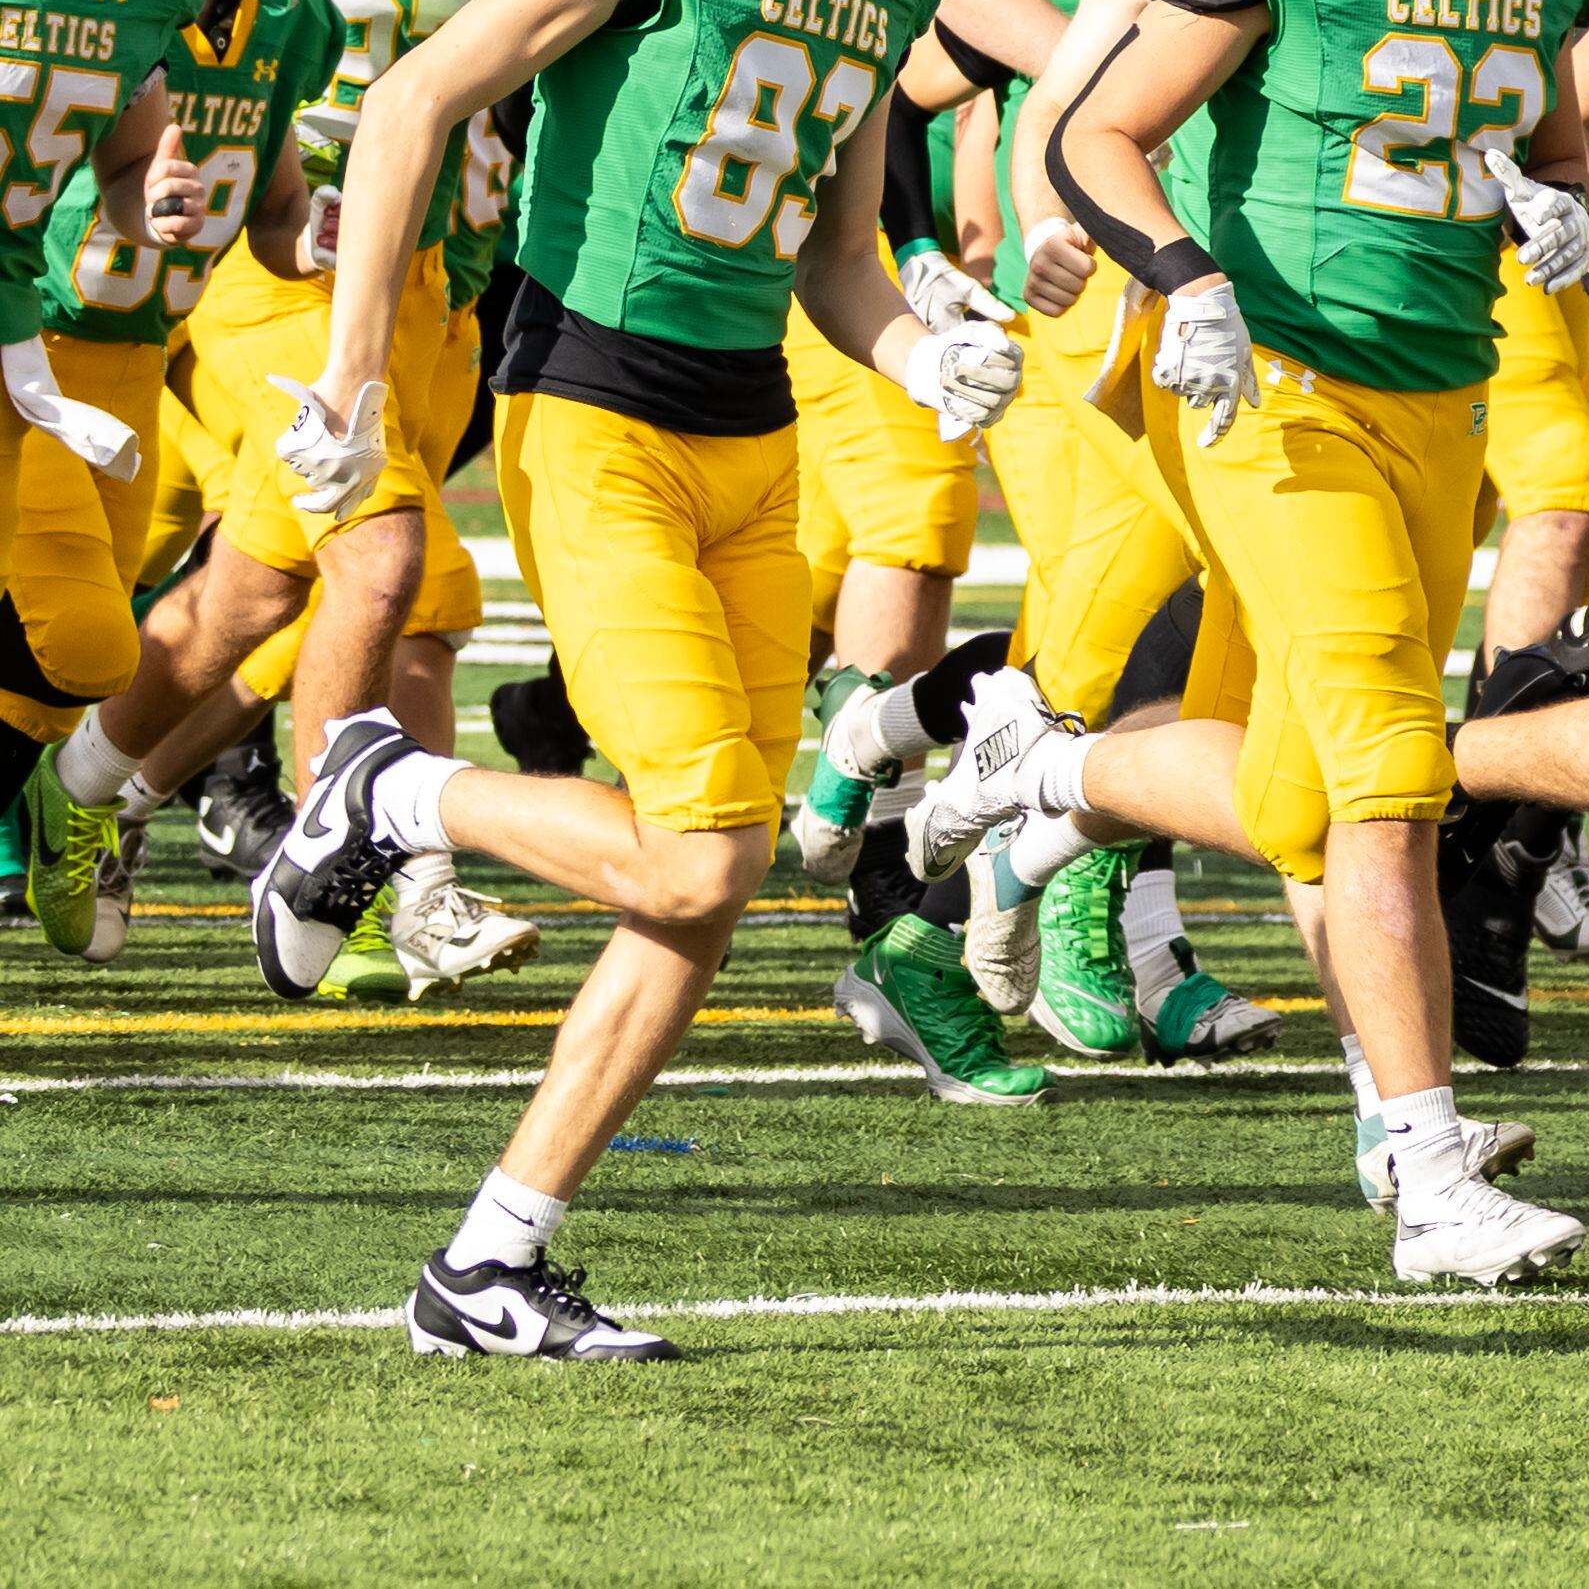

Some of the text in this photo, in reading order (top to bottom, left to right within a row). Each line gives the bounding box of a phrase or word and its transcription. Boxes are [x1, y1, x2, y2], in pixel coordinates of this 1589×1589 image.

[0, 5, 117, 61] ELTICS
[166, 91, 267, 138] ELTICS
[671, 30, 877, 260] 83
[1341, 31, 1546, 222] 22
[974, 720, 1019, 782] NIKE
